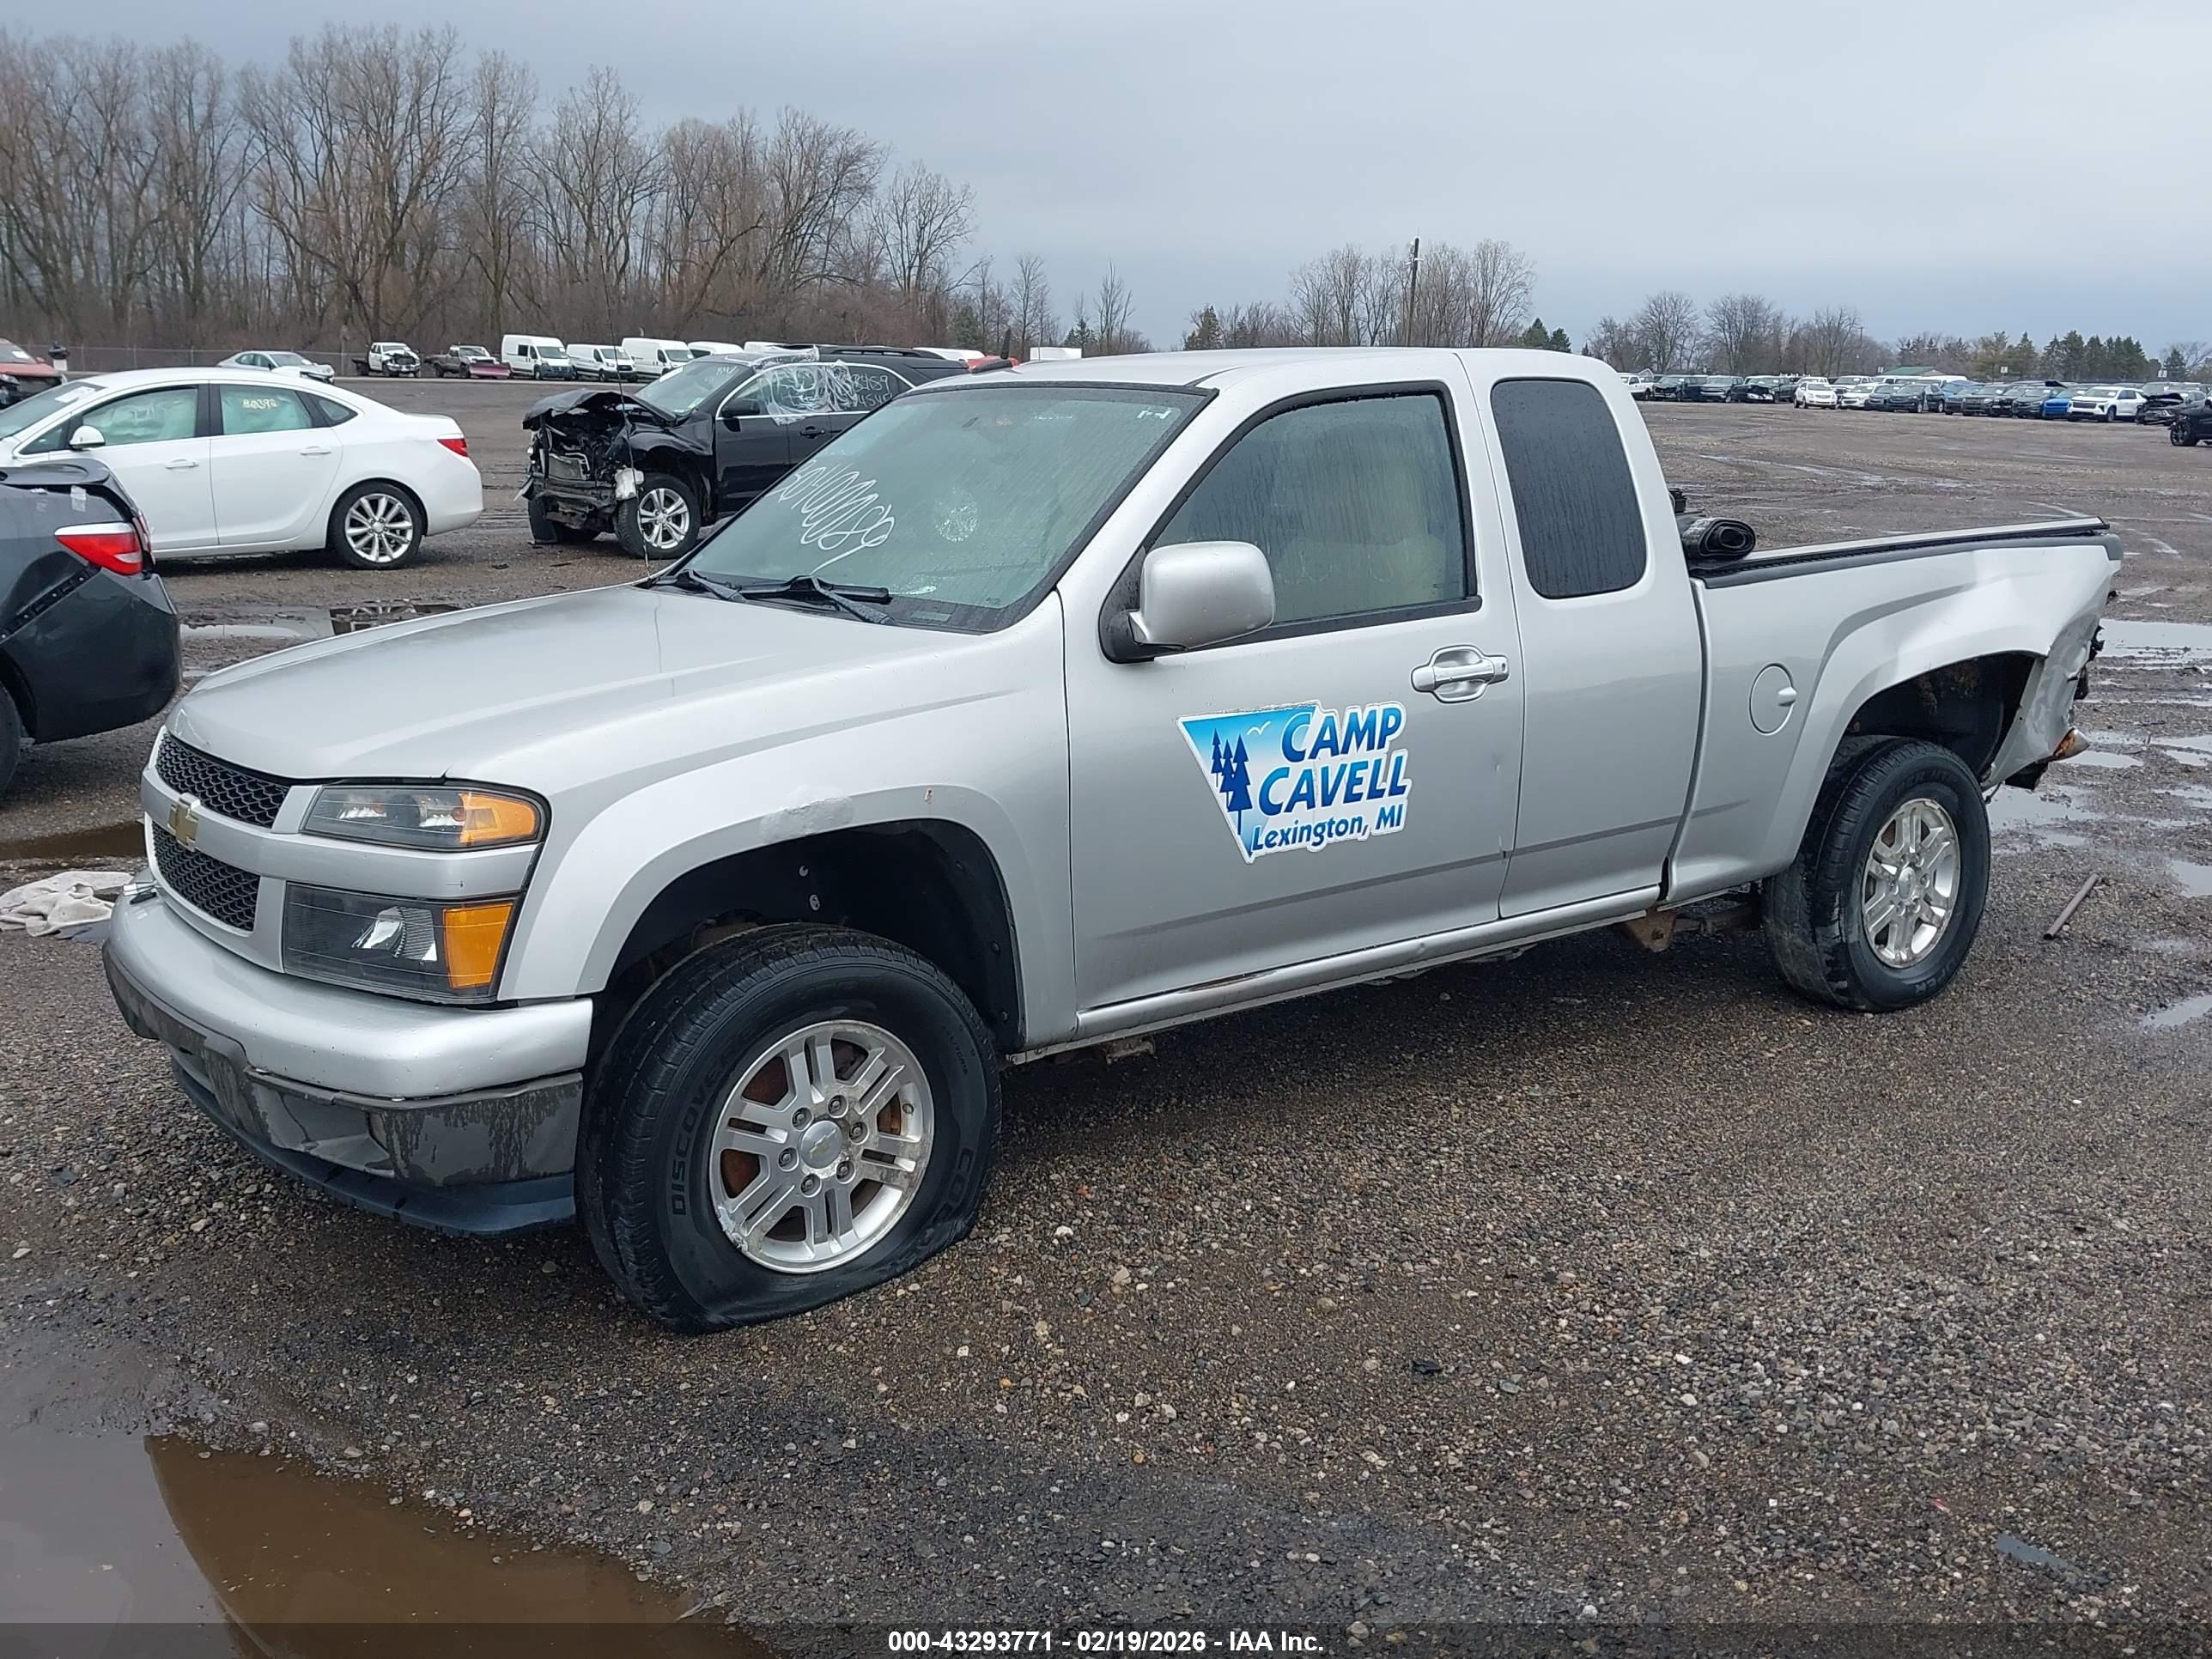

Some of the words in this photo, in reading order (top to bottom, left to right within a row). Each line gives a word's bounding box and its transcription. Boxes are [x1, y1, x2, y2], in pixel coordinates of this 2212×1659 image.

[1280, 706, 1402, 763] CAMP
[1257, 755, 1407, 817] CAVELL
[1251, 814, 1370, 852] Lexington,
[1374, 803, 1404, 830] MI
